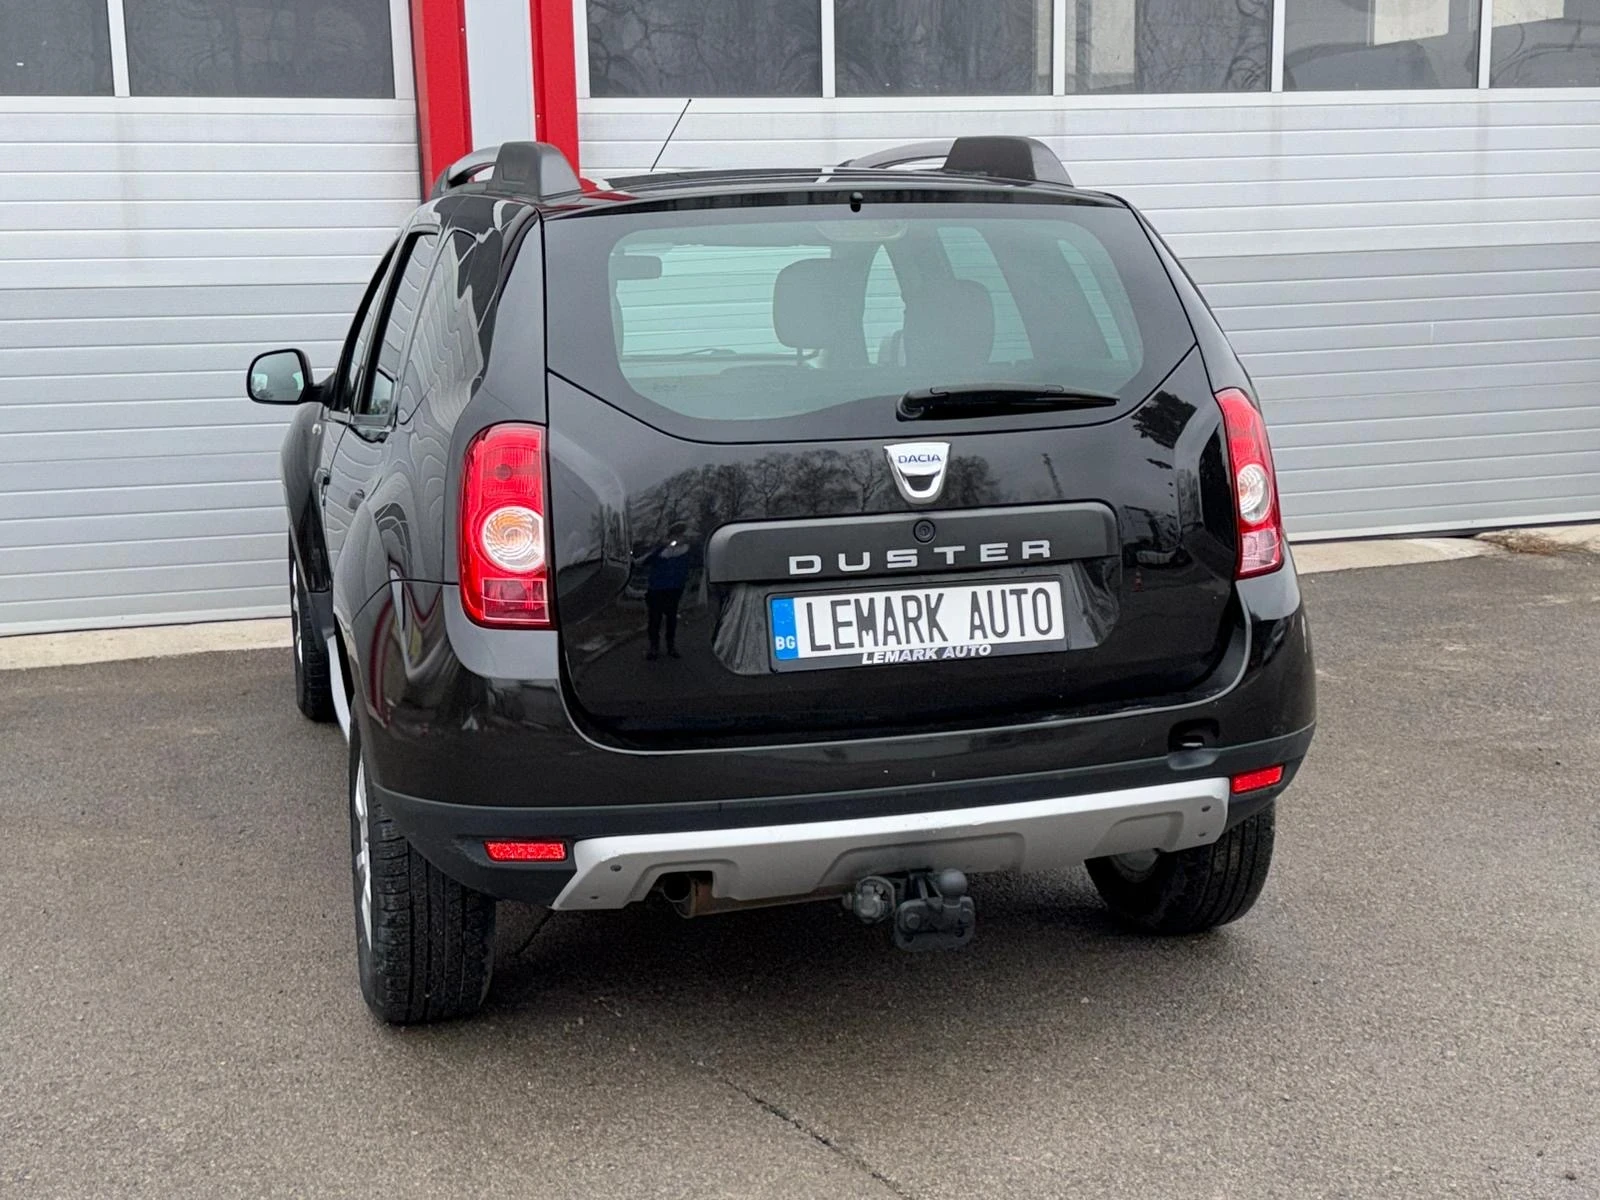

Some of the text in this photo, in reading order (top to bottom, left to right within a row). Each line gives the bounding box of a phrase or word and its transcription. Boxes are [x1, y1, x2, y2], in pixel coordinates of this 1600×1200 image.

[898, 454, 941, 463] DACIA
[789, 540, 1050, 574] DUSTER
[806, 587, 1053, 651] LEMARK AUTO
[775, 635, 795, 650] BG
[862, 644, 992, 664] LEMARK AUTO
